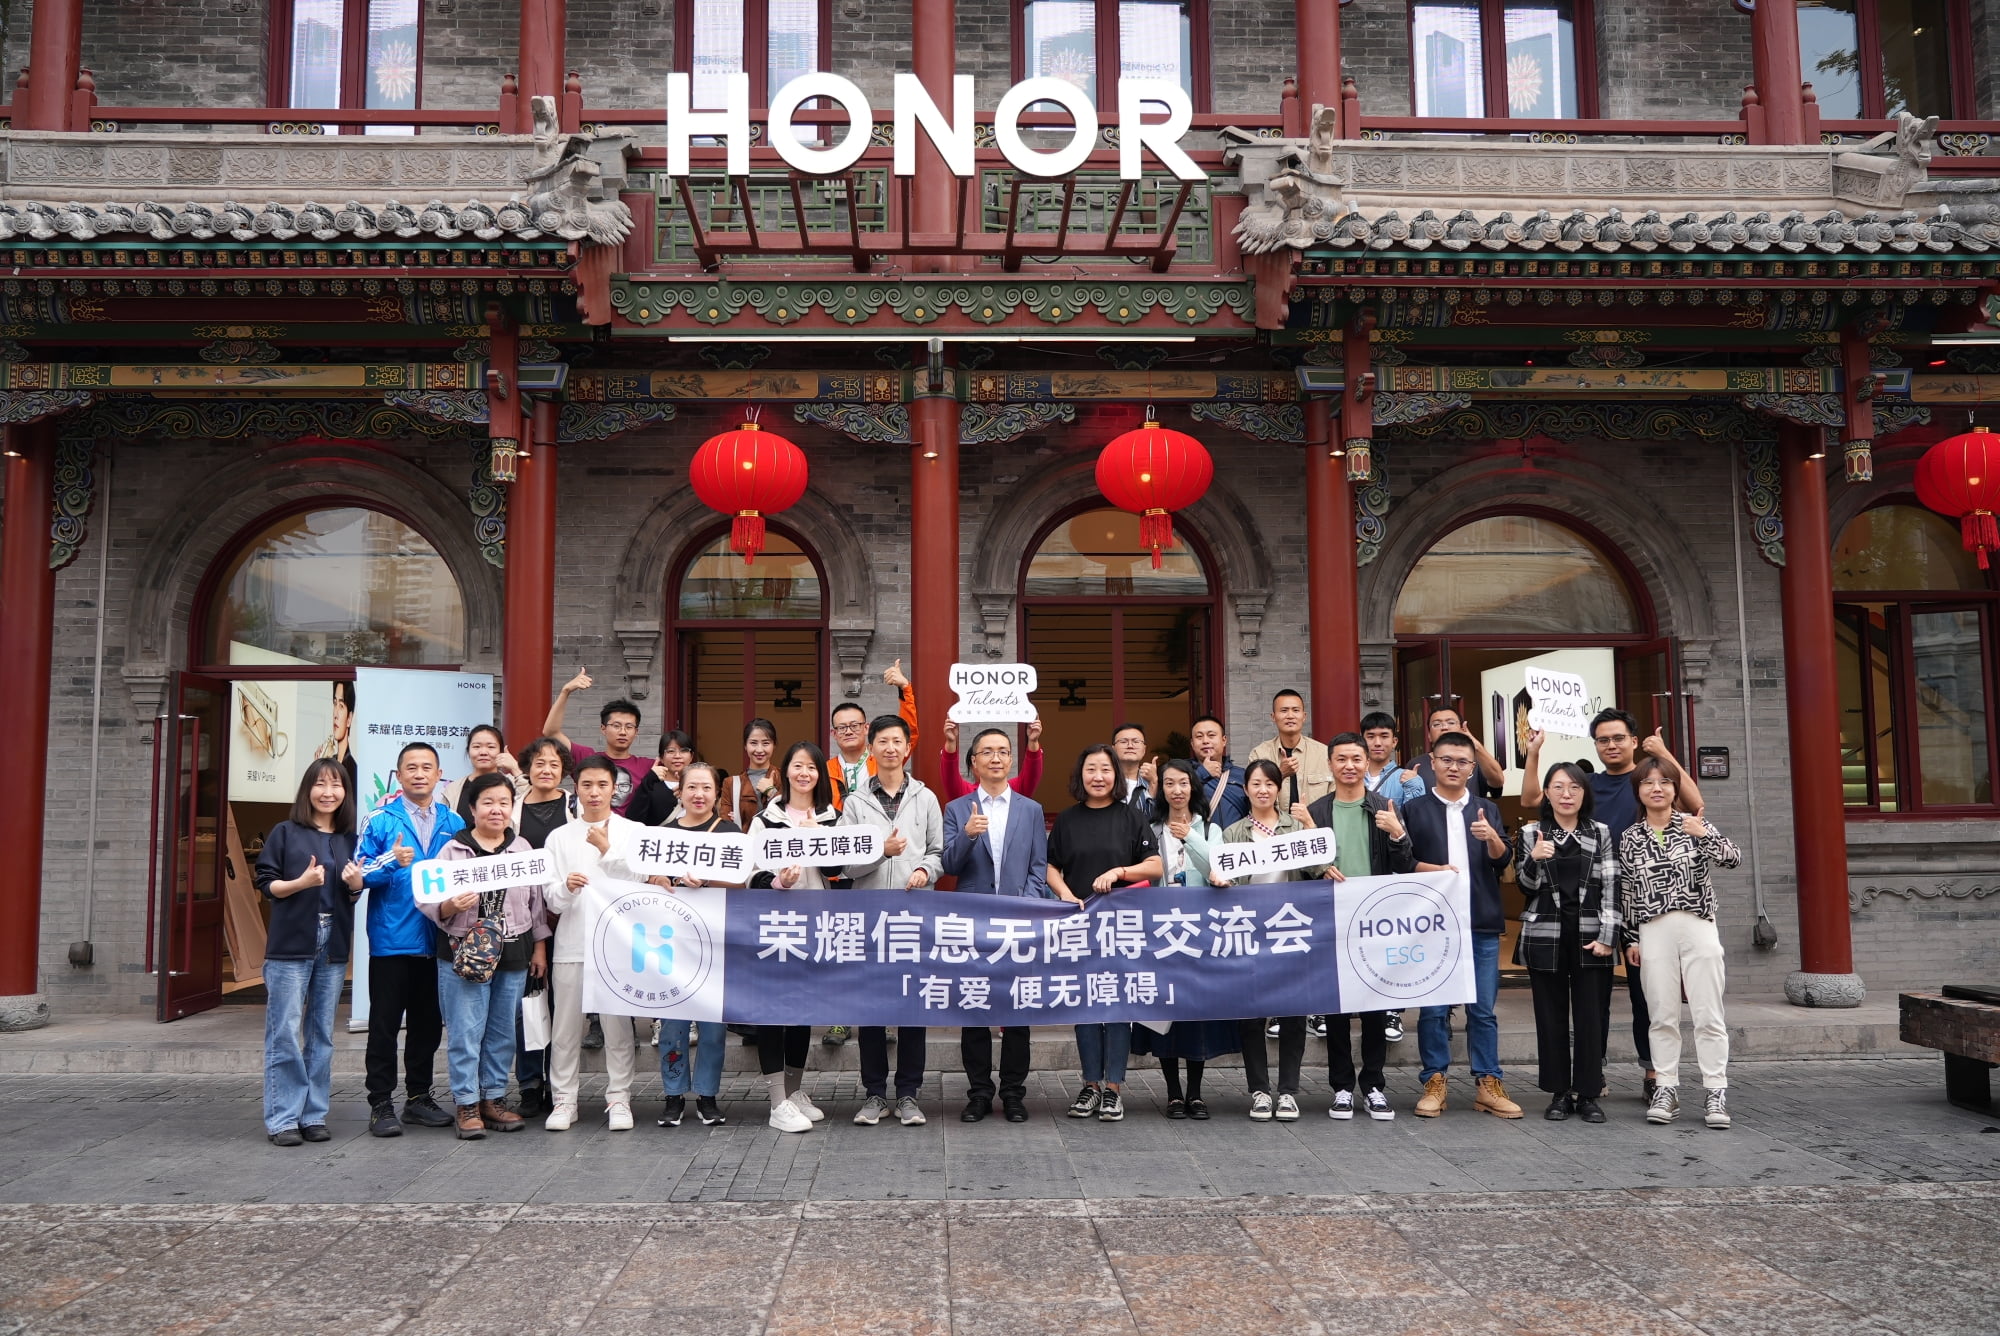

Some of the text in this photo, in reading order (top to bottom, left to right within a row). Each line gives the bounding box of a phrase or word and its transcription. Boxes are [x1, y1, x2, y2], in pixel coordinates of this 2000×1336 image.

[667, 71, 1209, 180] HONOR
[457, 682, 487, 690] HONOR
[956, 671, 1029, 685] HONOR
[1531, 675, 1582, 698] HONOR
[966, 689, 1019, 706] Talents
[1539, 698, 1577, 718] Talents
[1590, 696, 1603, 714] V2
[368, 723, 471, 737] 荣耀信息无障碍交流
[638, 838, 744, 870] 科技向善
[763, 835, 874, 859] 信息无障碍
[452, 858, 546, 886] 荣耀俱乐部
[615, 897, 692, 923] HONOR CLUB
[756, 902, 1314, 966] 荣耀信息无障碍交流会
[1359, 913, 1447, 938] HONOR
[1385, 944, 1425, 966] ESG
[622, 983, 681, 1002] 荣耀俱乐部
